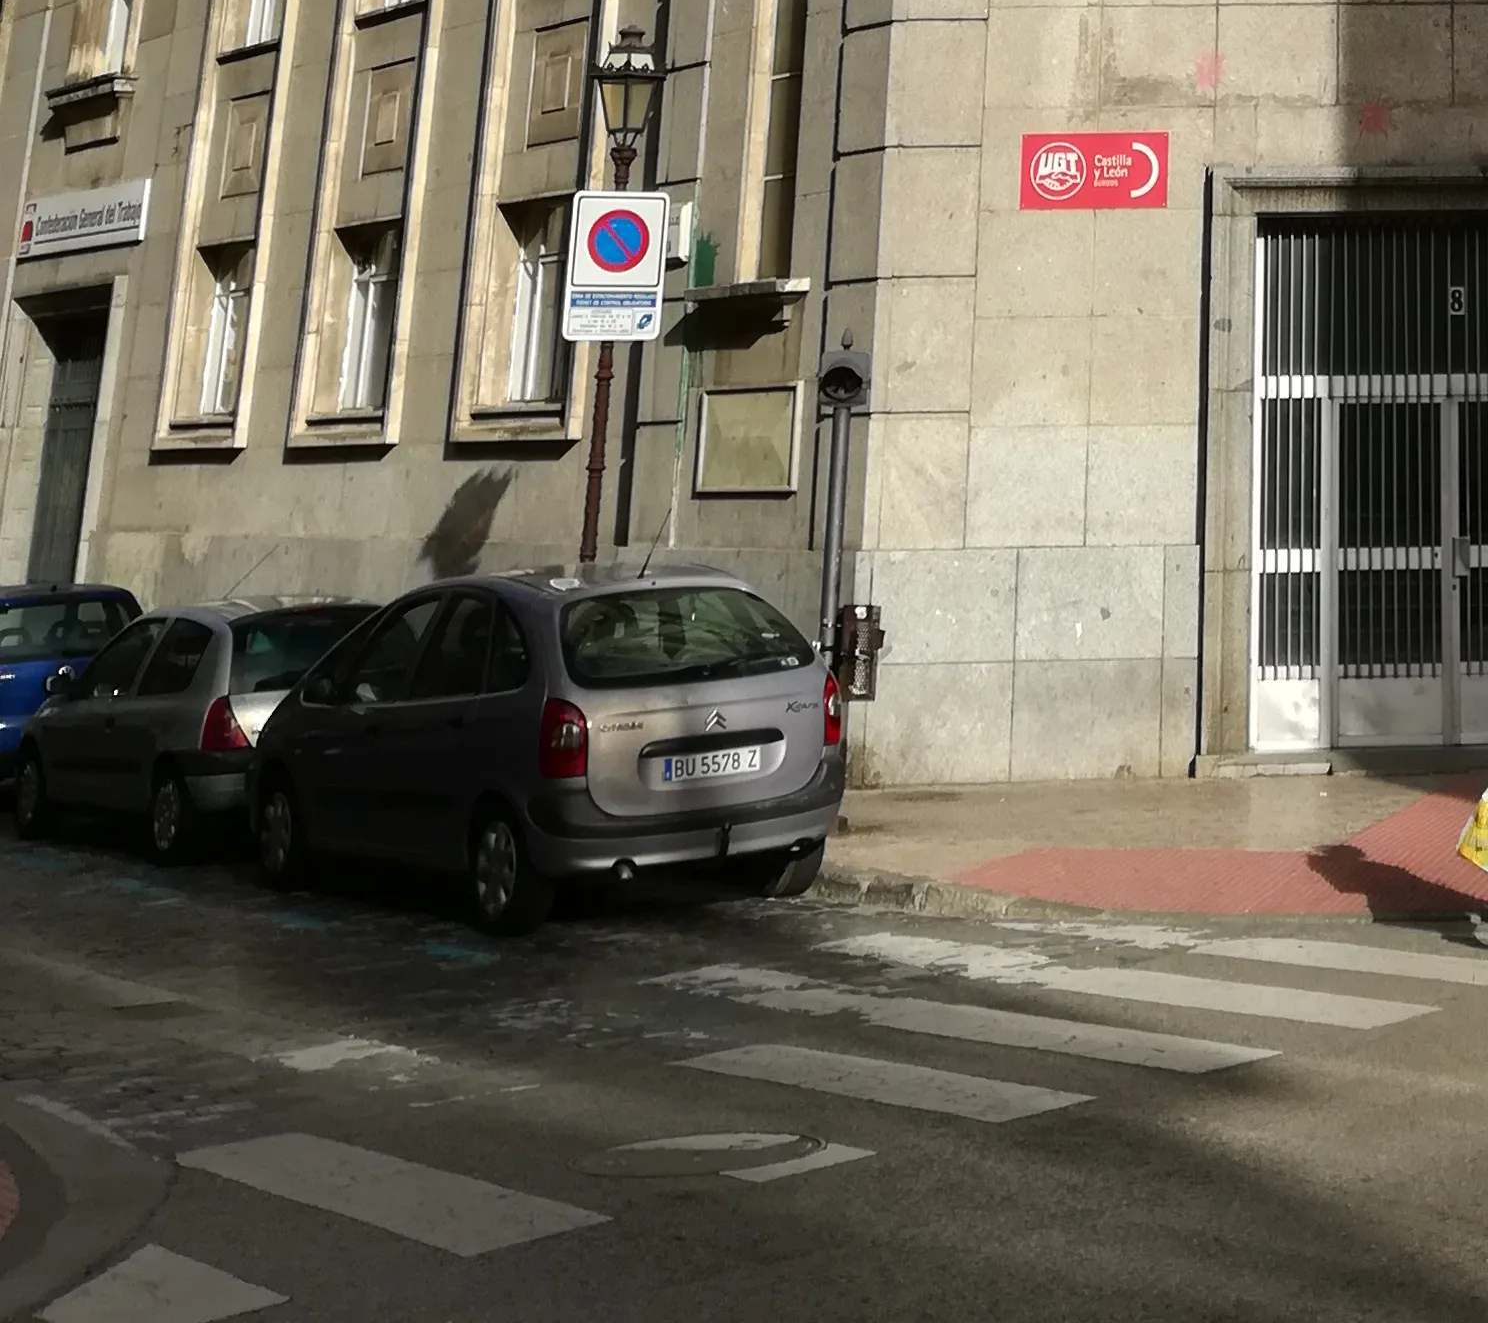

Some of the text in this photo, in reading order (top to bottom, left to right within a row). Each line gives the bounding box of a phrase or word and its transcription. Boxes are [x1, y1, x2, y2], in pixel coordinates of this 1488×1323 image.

[1038, 152, 1079, 173] UGT
[1094, 154, 1132, 167] Castilla
[1093, 165, 1128, 180] y León
[79, 204, 105, 229] General
[105, 203, 116, 225] del
[1451, 289, 1463, 312] 8
[674, 749, 757, 778] BU 5578 Z
